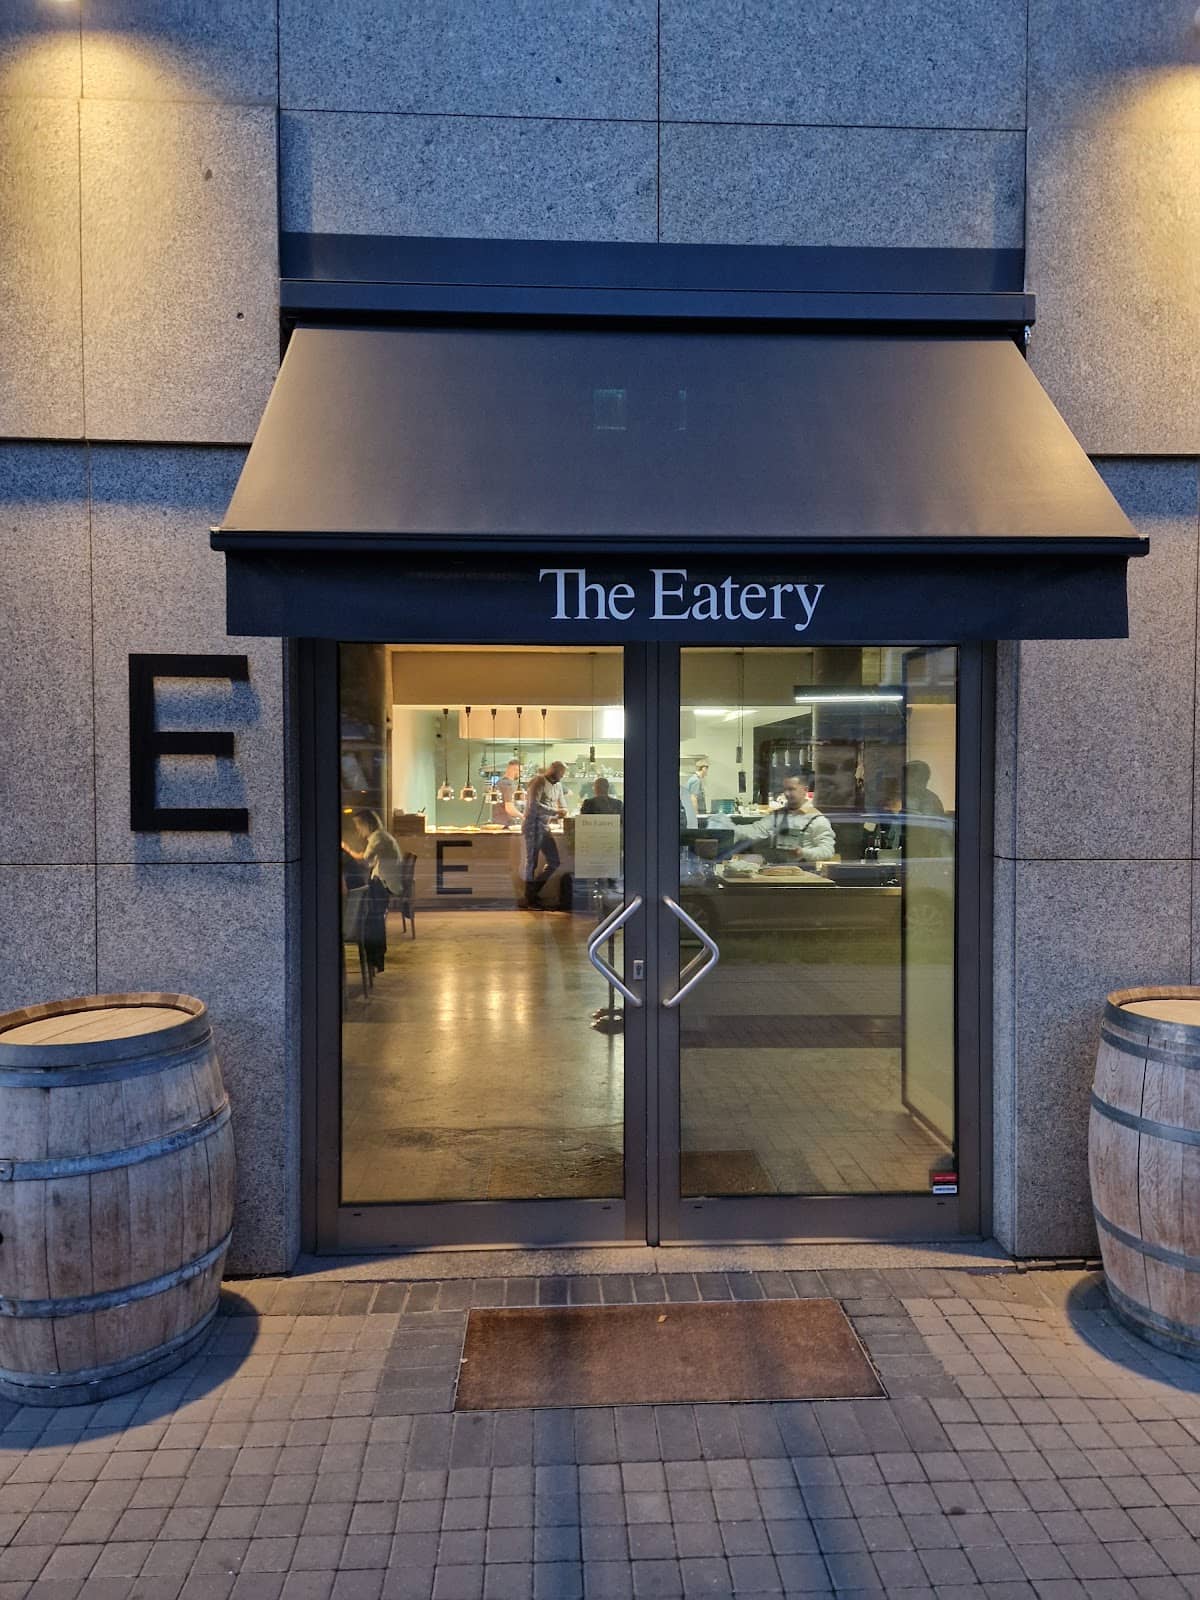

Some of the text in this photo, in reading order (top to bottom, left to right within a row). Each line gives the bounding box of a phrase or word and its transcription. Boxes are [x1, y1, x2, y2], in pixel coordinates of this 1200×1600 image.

[539, 568, 825, 631] The Eatery
[129, 654, 249, 832] E
[436, 840, 472, 895] E
